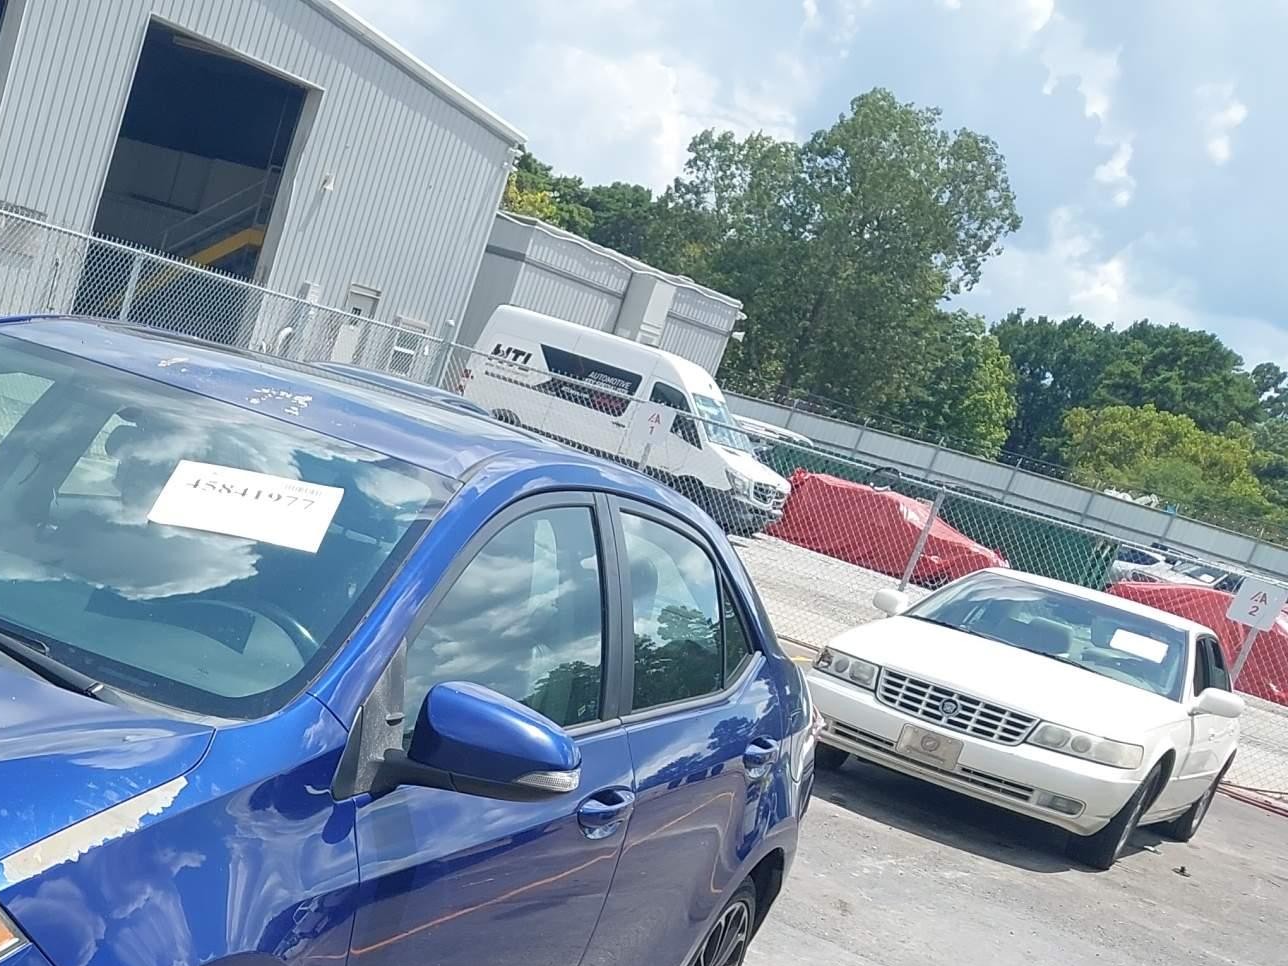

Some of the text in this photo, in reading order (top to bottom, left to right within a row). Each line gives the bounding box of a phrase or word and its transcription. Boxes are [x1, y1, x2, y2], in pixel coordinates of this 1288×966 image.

[588, 371, 632, 389] AUTOMOTIVE
[185, 478, 316, 511] 45841977
[1248, 605, 1259, 616] 2
